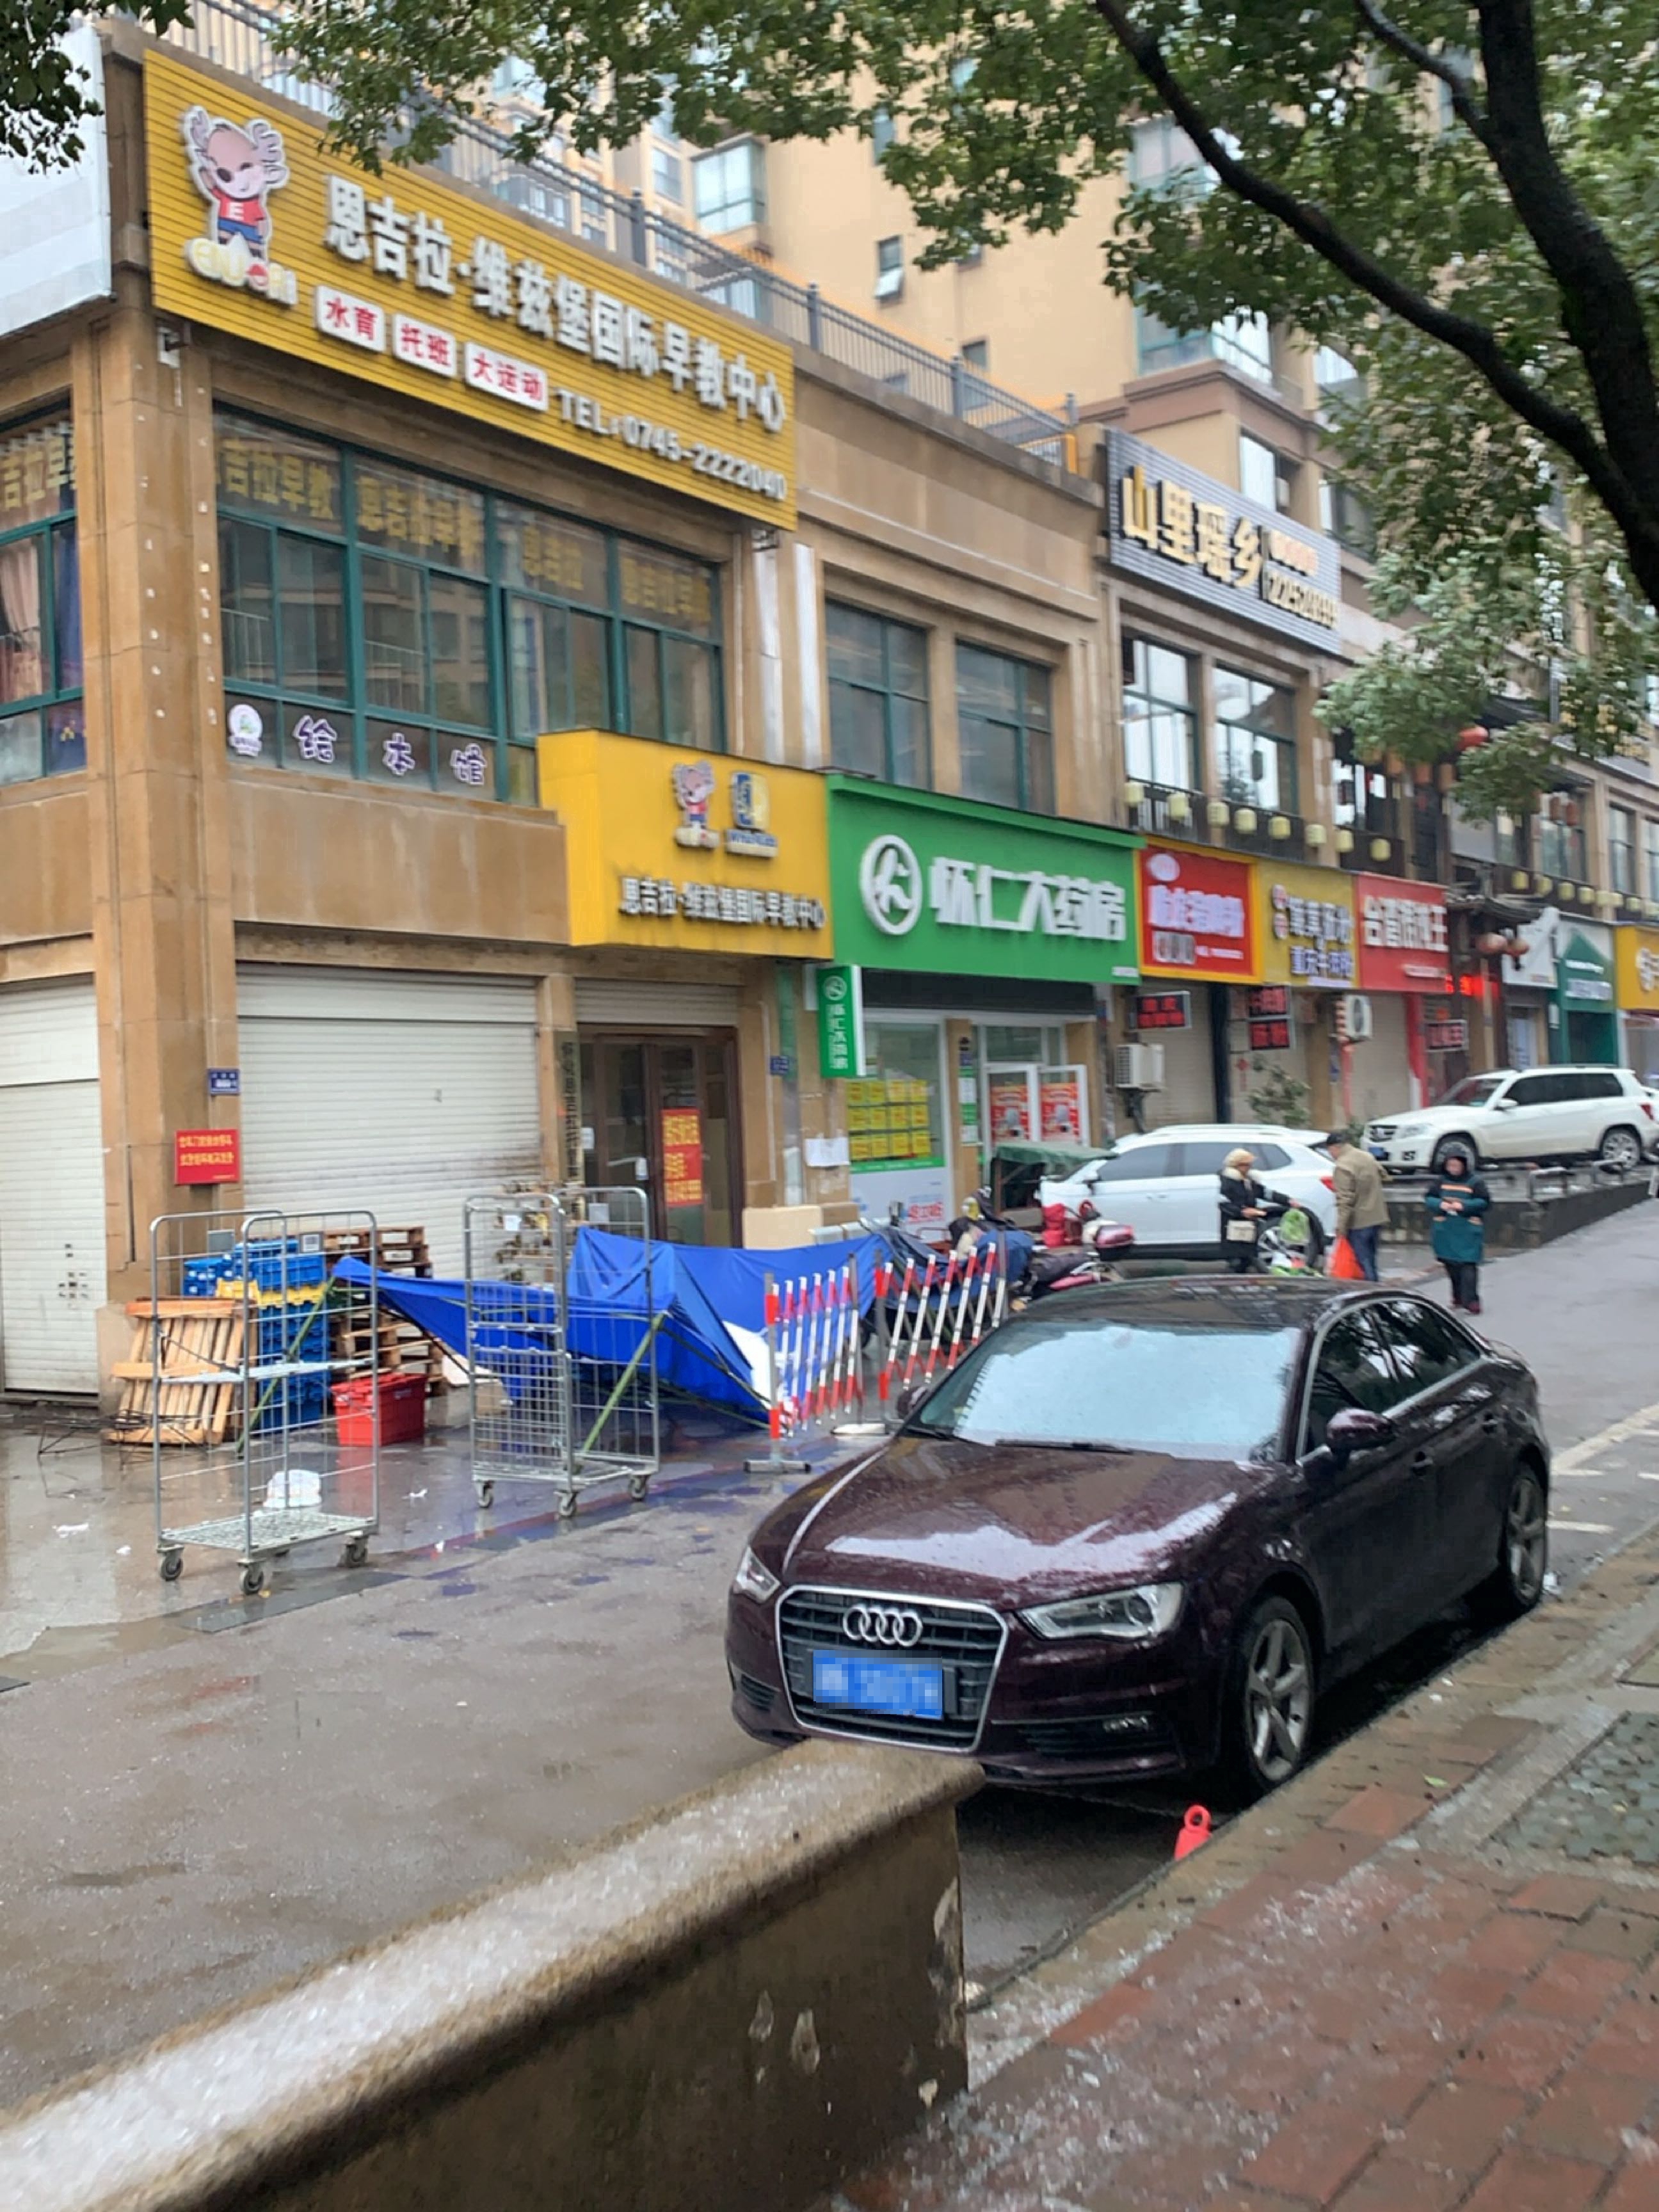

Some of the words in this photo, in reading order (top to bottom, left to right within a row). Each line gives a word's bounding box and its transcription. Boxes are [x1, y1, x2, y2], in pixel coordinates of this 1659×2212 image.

[326, 297, 377, 341] 水育
[401, 323, 452, 367] 托班
[474, 352, 543, 402] 大运动
[216, 438, 333, 520] 吉拉早教
[294, 715, 488, 786] 绘本馆
[930, 856, 1126, 942] 怀仁大药房
